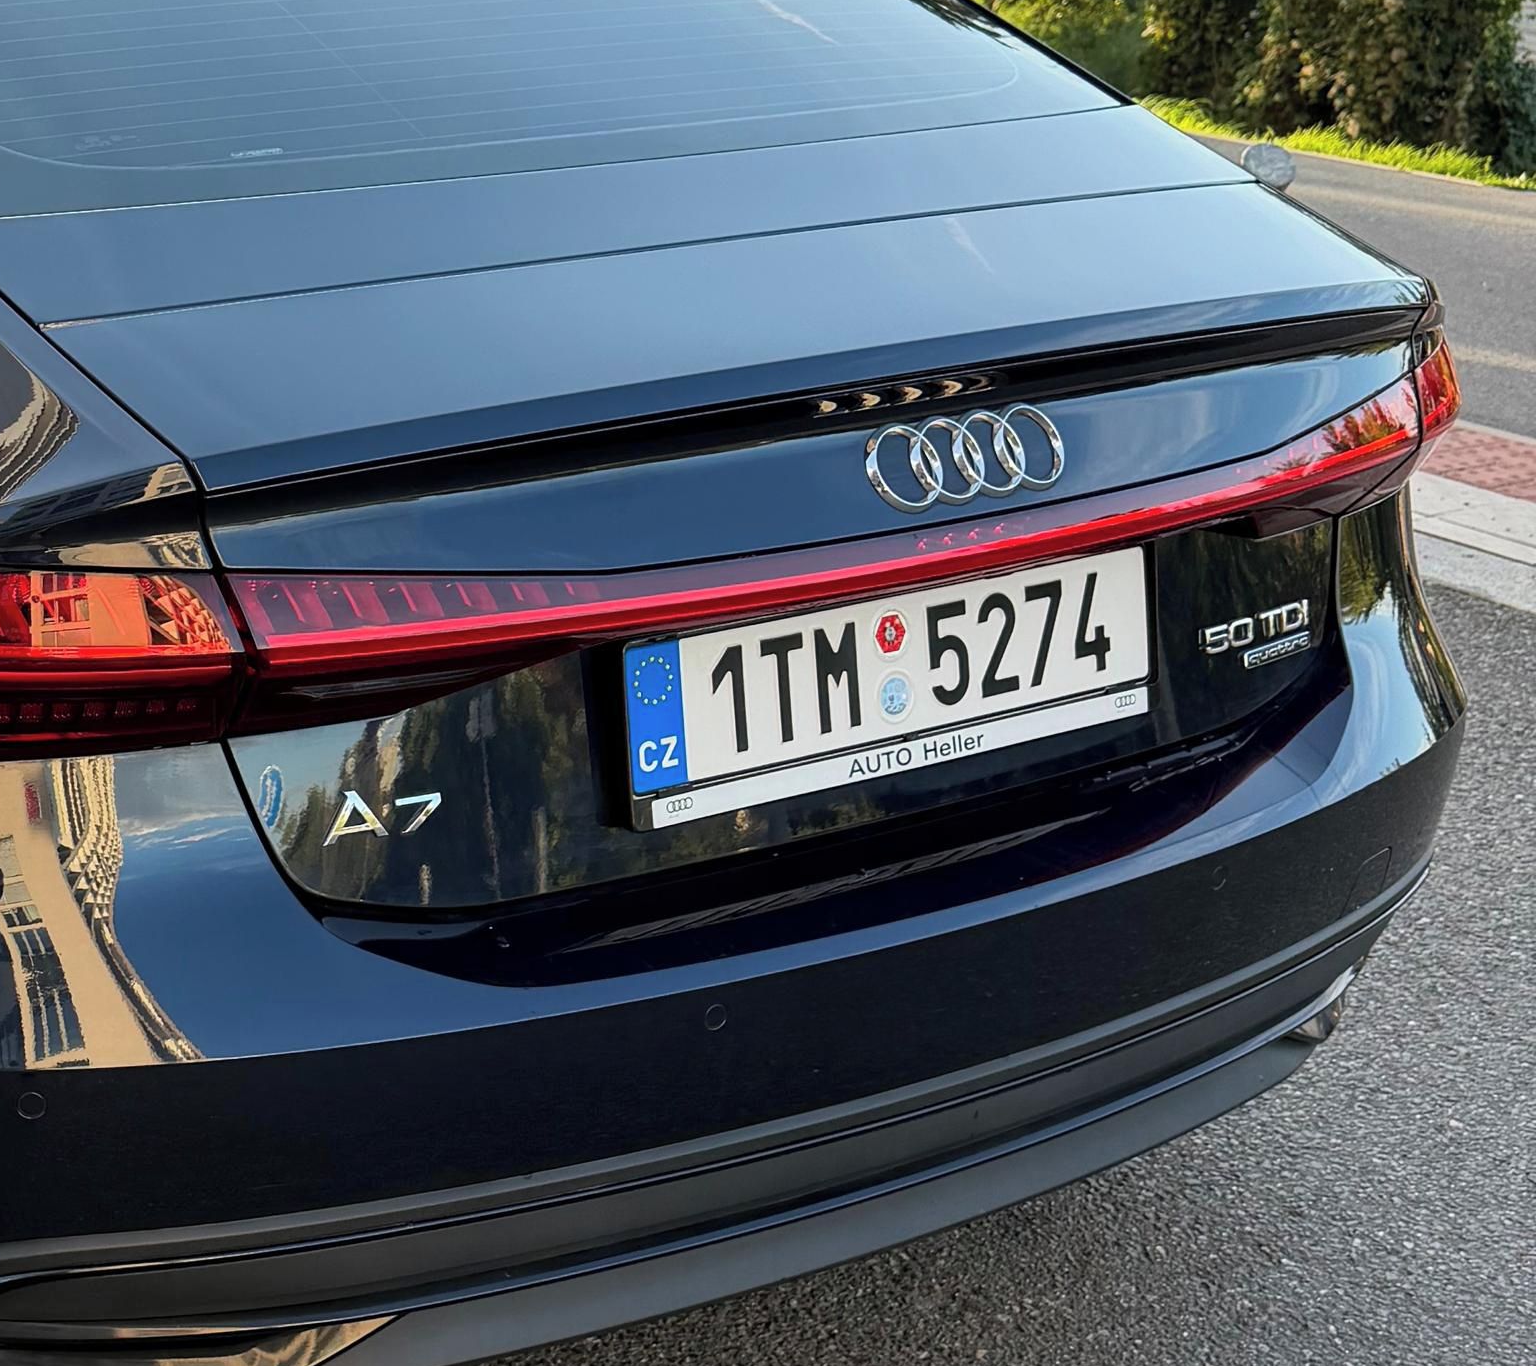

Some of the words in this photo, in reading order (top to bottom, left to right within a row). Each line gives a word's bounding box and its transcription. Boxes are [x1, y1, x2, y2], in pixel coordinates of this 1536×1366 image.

[1200, 617, 1254, 654] 50
[1257, 599, 1309, 637] TDI
[1248, 635, 1310, 664] quattro
[710, 621, 862, 754] 1TM
[925, 571, 1111, 706] 5274
[637, 735, 679, 774] CZ
[848, 747, 913, 778] AUTO
[922, 732, 985, 760] Heller
[322, 790, 442, 847] A7
